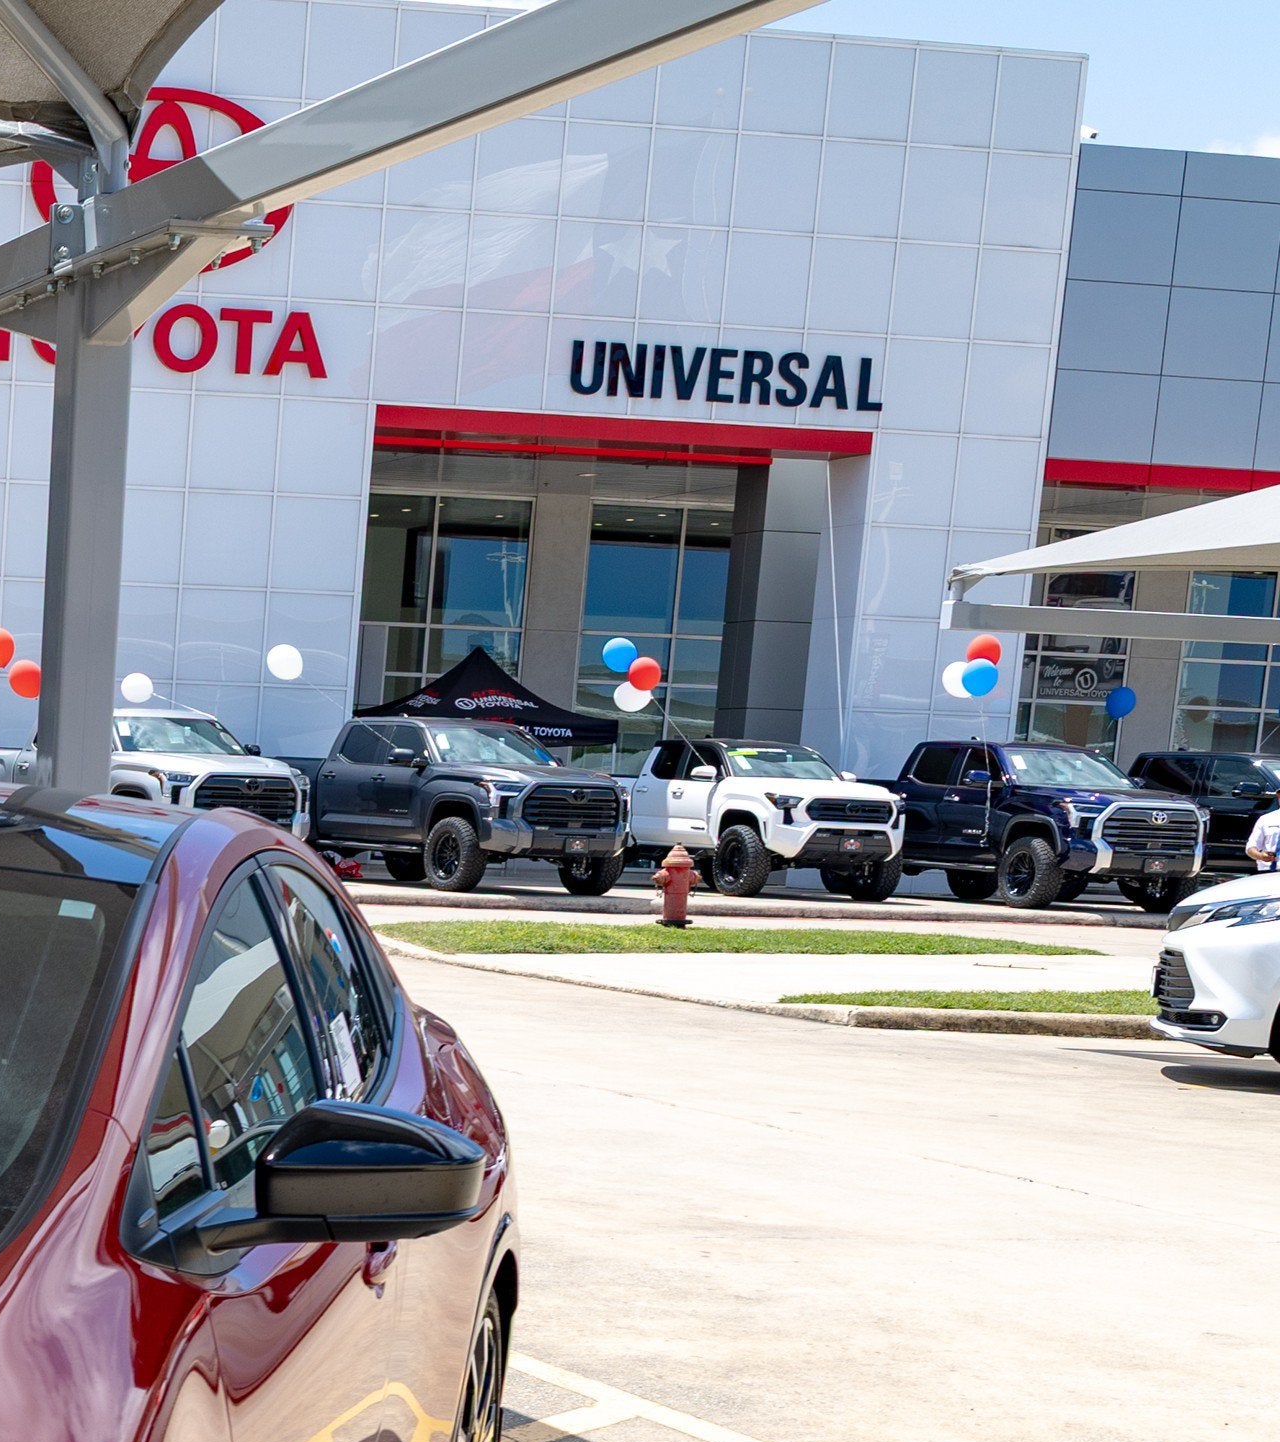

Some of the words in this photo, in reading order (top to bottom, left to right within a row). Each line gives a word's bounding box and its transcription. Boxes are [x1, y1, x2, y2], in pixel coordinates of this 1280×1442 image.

[569, 339, 883, 412] UNIVERSAL
[1040, 687, 1084, 697] UNIVERSAL
[533, 726, 573, 737] TOYOTA
